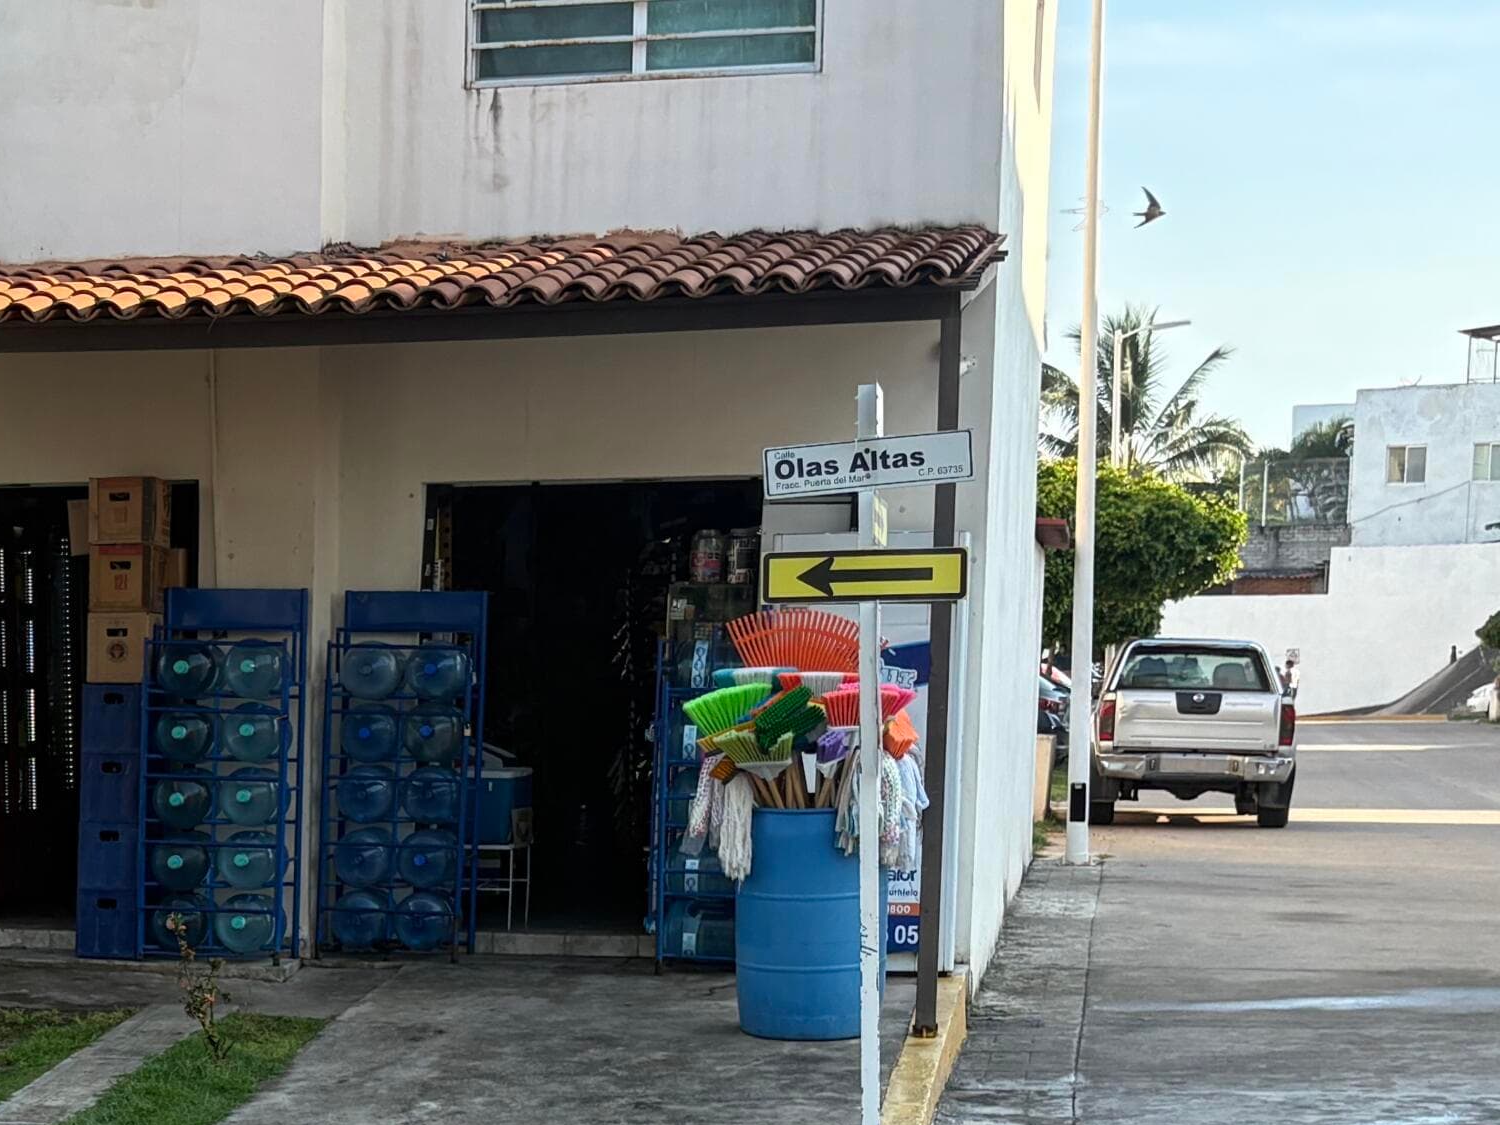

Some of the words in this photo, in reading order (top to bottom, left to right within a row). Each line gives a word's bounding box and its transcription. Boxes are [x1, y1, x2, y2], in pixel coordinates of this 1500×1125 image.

[774, 451, 795, 459] Calle
[774, 458, 839, 480] Olas
[849, 450, 925, 473] Altas
[918, 468, 935, 476] C.P.
[937, 464, 964, 475] 63735
[804, 478, 831, 488] Puerta
[833, 476, 846, 484] del
[849, 474, 866, 483] Mar
[894, 924, 918, 945] 05
